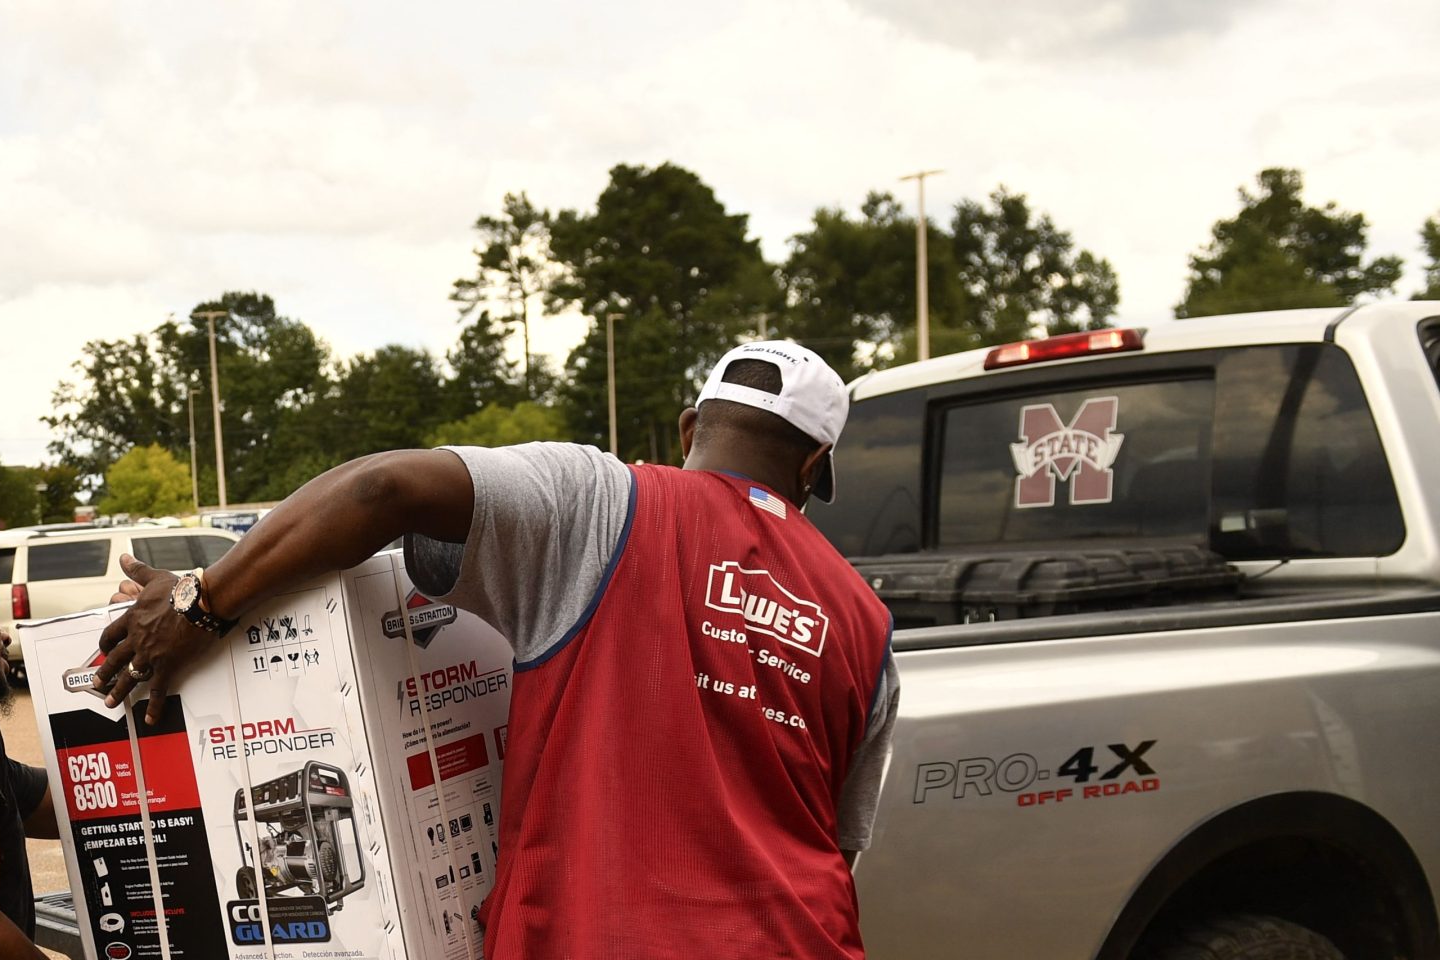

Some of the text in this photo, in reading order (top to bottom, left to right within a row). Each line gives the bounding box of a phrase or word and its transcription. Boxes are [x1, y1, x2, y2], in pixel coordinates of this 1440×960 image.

[1033, 434, 1098, 467] STATE
[386, 606, 453, 631] BRIGS&STRATTON
[720, 572, 815, 643] LWE'S
[702, 620, 811, 684] Custo Service
[68, 673, 96, 686] BRIGG
[405, 660, 478, 698] STORM
[713, 679, 734, 695] us
[738, 684, 757, 700] at
[409, 673, 508, 718] RESPONDER
[208, 717, 296, 744] STORM
[402, 731, 412, 739] How
[212, 732, 335, 761] RESPONDER
[68, 752, 112, 783] 6250
[74, 780, 118, 811] 8500
[1017, 778, 1161, 807] OFF ROAD
[81, 816, 194, 836] GETTING STARTD IS EASY!
[84, 833, 167, 852] ¡EMPEZAR ES FCIL!
[235, 921, 327, 941] GUARD
[235, 952, 263, 960] Advanced
[302, 949, 365, 958] Detección avanzada.
